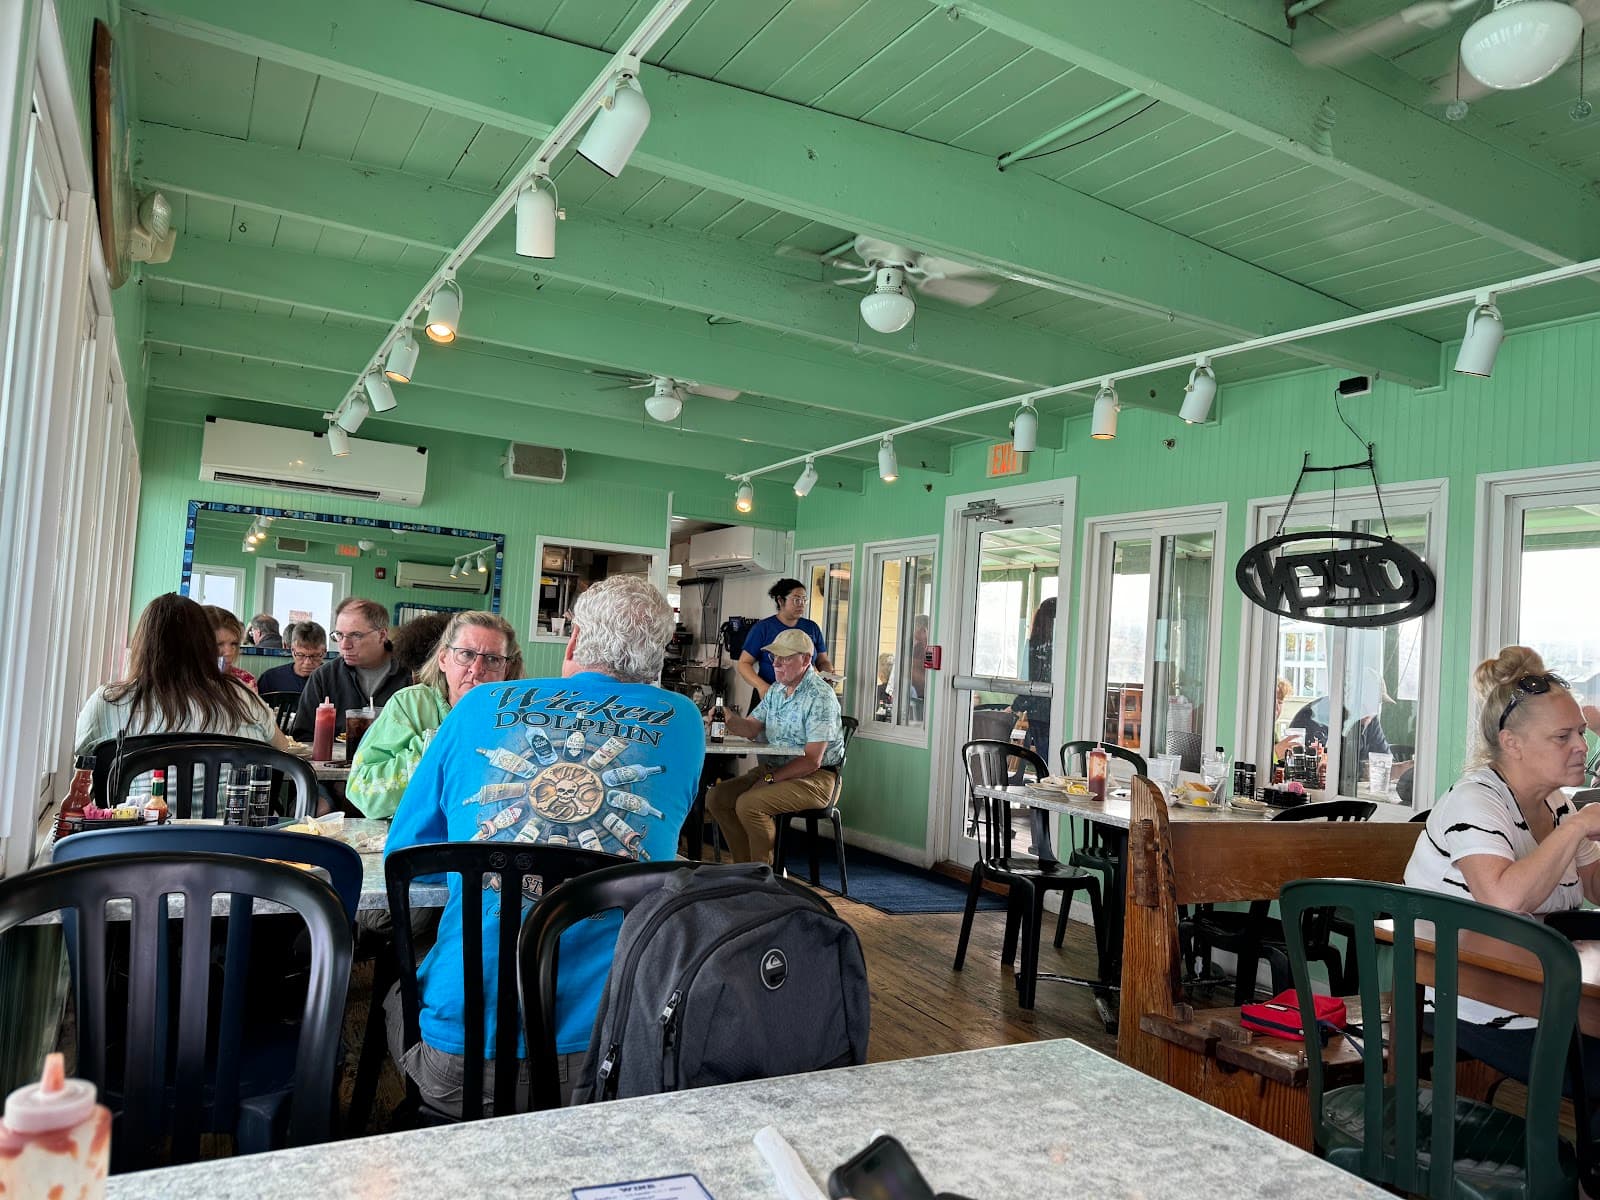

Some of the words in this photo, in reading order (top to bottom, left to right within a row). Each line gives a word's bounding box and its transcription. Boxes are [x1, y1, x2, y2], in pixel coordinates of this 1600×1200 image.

[992, 442, 1017, 474] EXIT
[490, 686, 676, 726] Wicked
[494, 711, 663, 748] DOLPHIN
